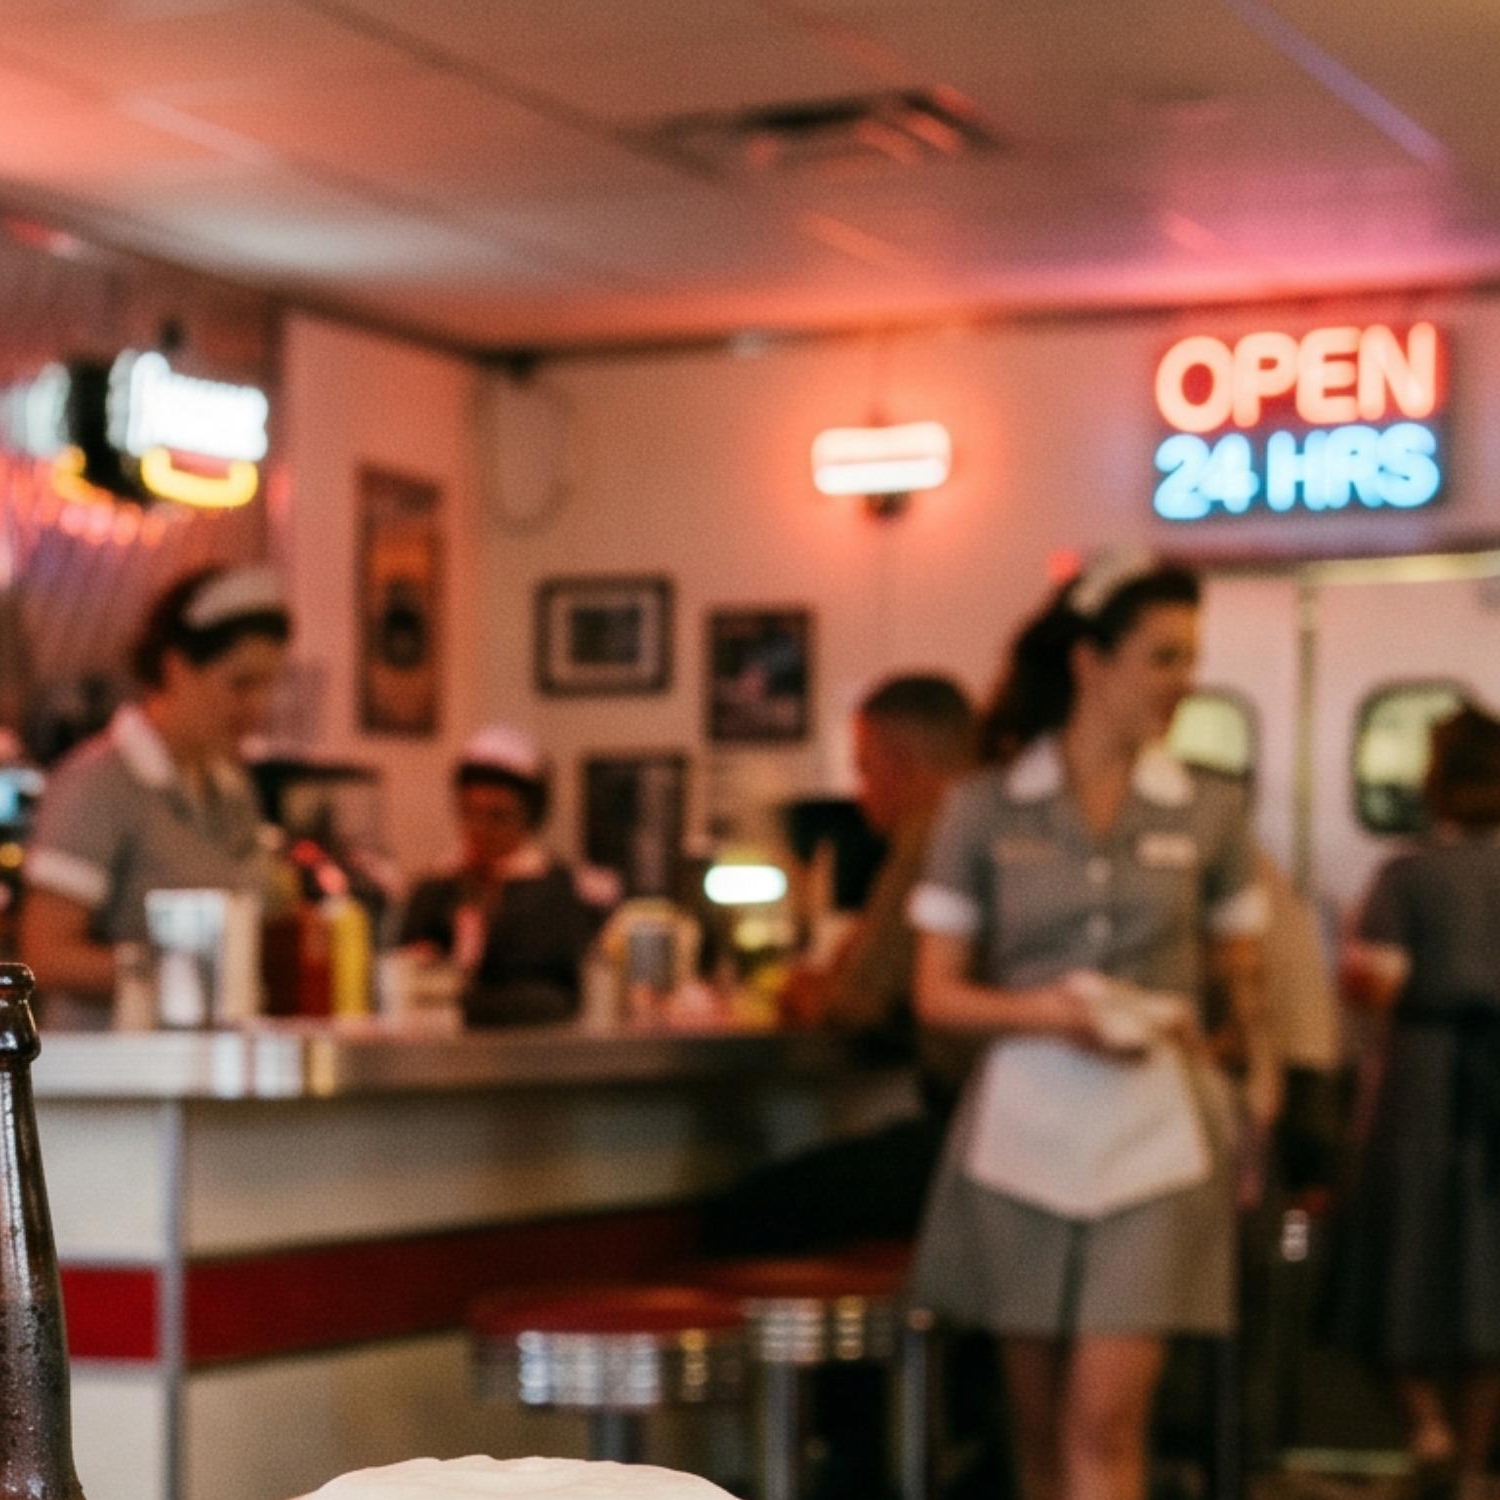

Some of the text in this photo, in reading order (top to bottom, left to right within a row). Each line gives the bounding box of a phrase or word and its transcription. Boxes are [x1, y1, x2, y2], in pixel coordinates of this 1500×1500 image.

[1155, 321, 1437, 433] OPEN
[1153, 421, 1441, 521] 24 HRS
